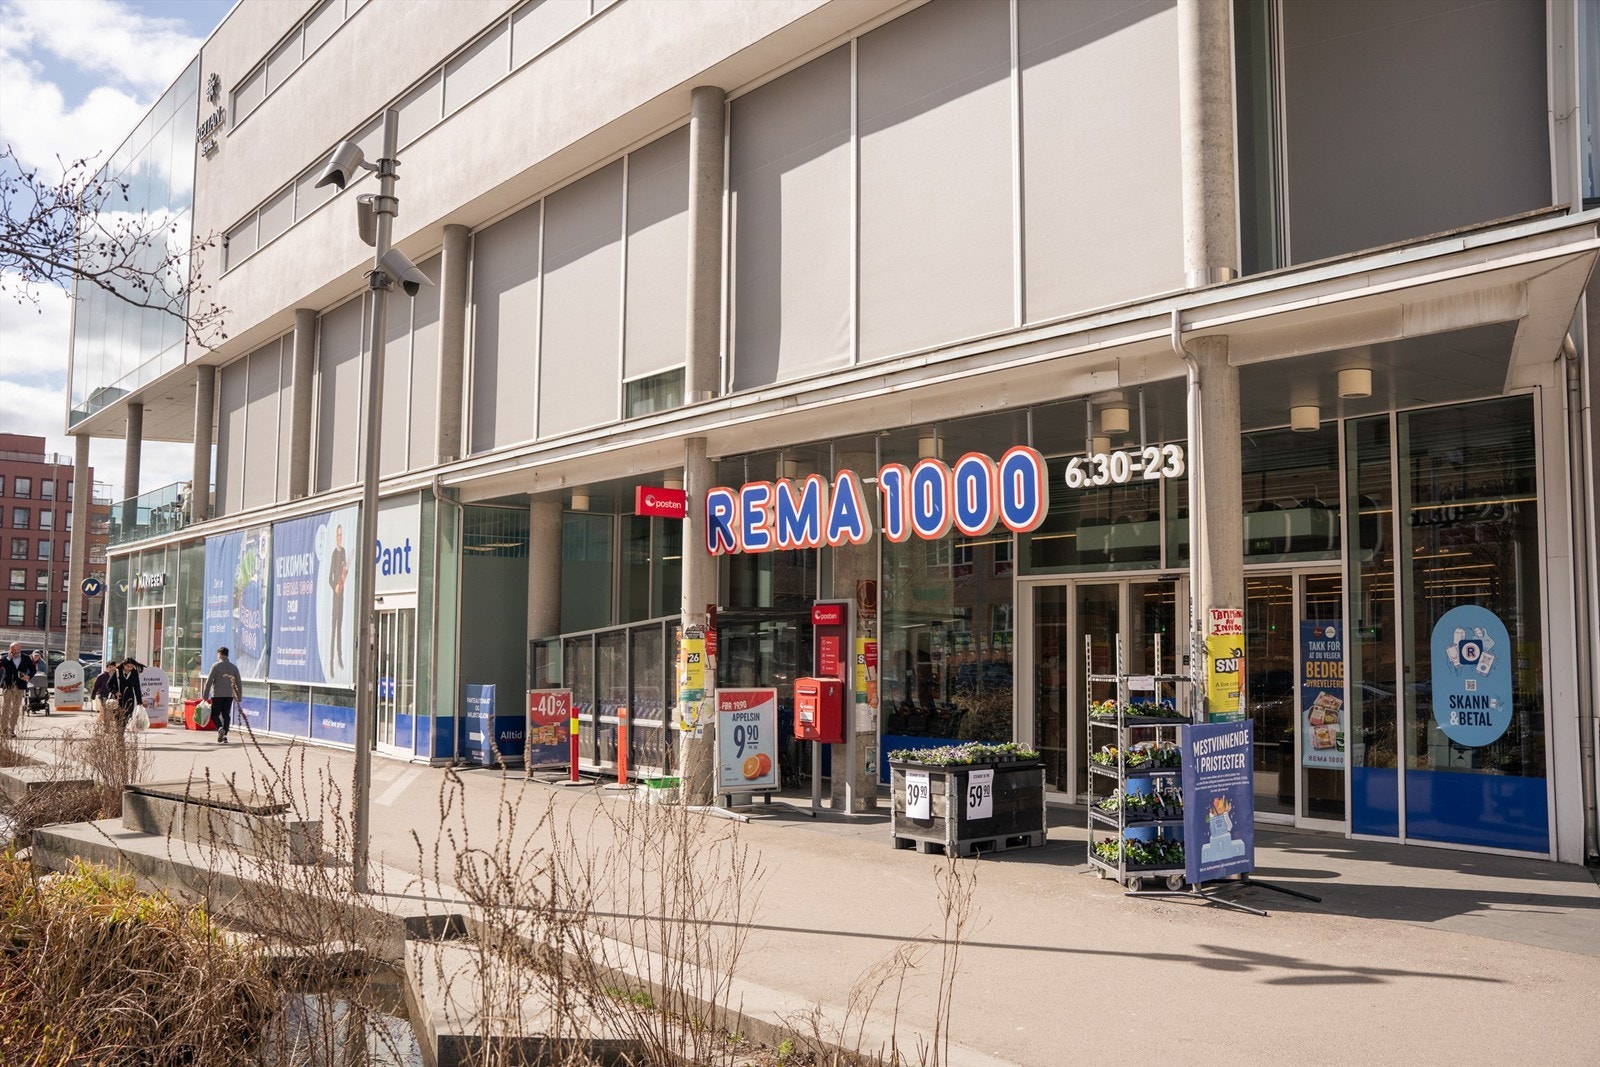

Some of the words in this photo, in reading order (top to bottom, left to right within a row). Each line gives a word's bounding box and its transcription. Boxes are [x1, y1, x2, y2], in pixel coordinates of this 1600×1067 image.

[1065, 444, 1184, 488] 6.30-23
[656, 500, 682, 508] posten
[706, 469, 870, 556] REMA
[878, 445, 1046, 543] 1000
[276, 552, 314, 578] VELKOMMEN
[376, 538, 412, 576] Pant
[1308, 641, 1326, 650] TAKK
[1327, 641, 1340, 651] FOR
[1306, 662, 1344, 678] BEDRE
[531, 695, 566, 716] -40%
[1450, 695, 1490, 709] SKANN
[732, 712, 760, 722] APPELSIN
[1450, 711, 1492, 726] &BETAL
[500, 731, 522, 739] Alltid
[734, 725, 746, 759] 9
[747, 725, 759, 740] 90
[1192, 729, 1250, 757] MESTVINNENDE
[1201, 754, 1245, 773] PRISTESTER
[908, 784, 919, 806] 39
[920, 786, 927, 796] 90
[970, 785, 982, 807] 59
